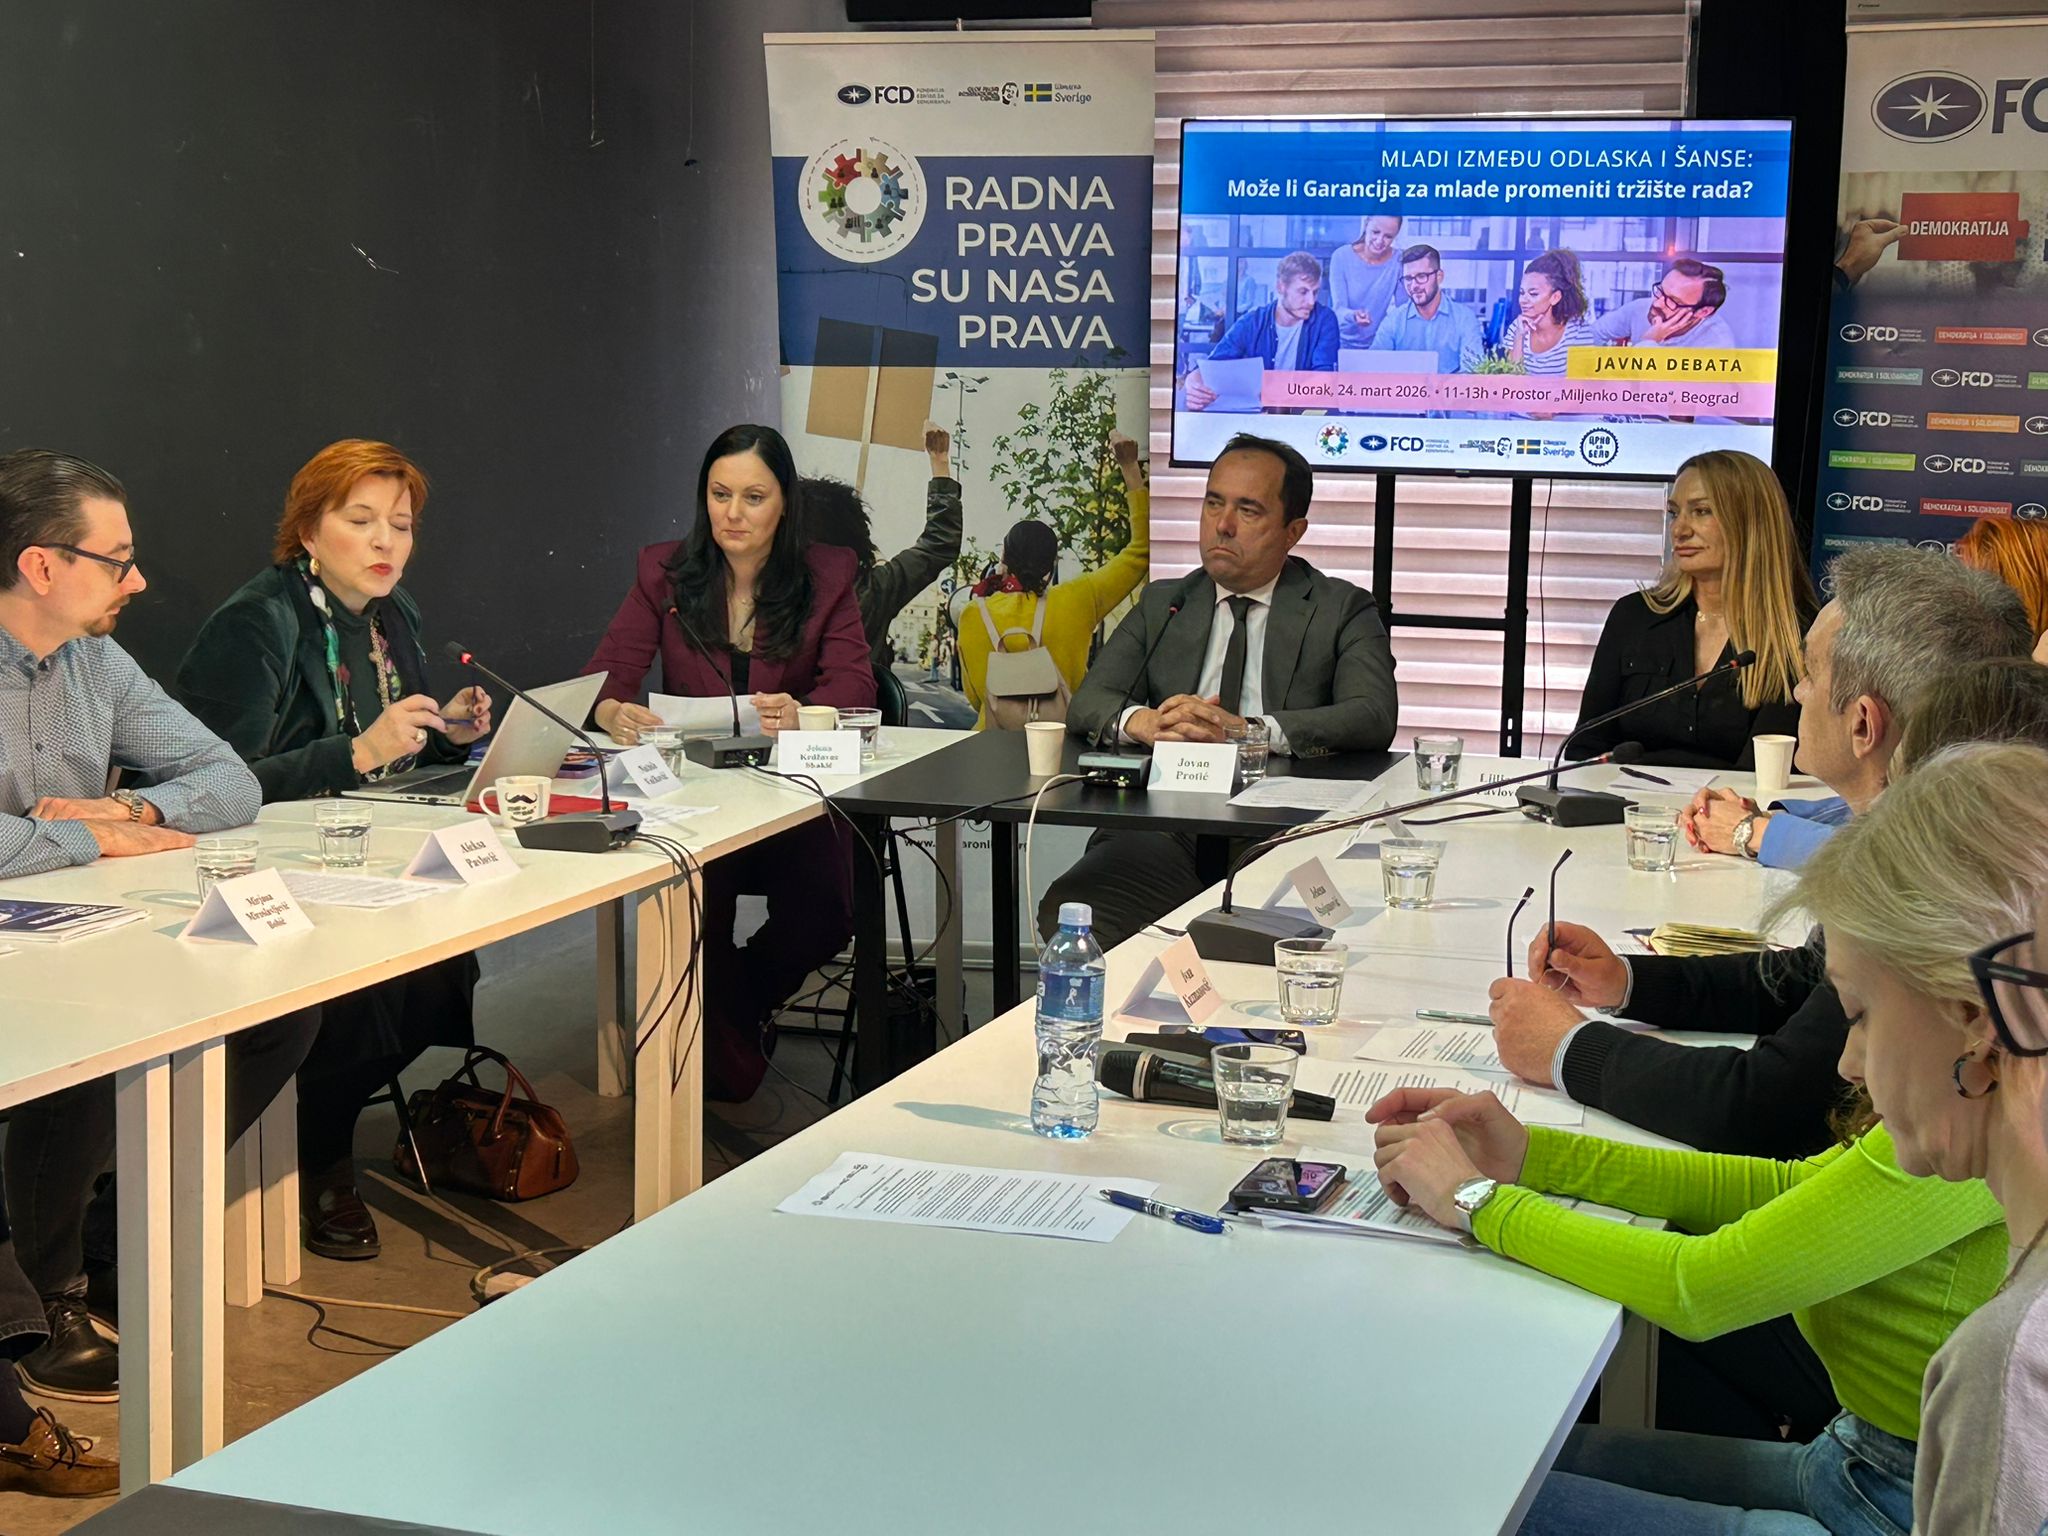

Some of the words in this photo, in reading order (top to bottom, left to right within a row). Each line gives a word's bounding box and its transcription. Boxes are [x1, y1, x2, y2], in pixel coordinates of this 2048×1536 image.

[874, 86, 915, 104] FCD
[1381, 149, 1448, 168] MLADI
[1457, 149, 1542, 168] IZMEĐU
[1550, 149, 1653, 168] ODLASKA
[1661, 149, 1666, 167] I
[1674, 144, 1753, 168] ŠANSE:
[945, 176, 1115, 211] RADNA
[1227, 178, 1281, 197] Može
[1286, 178, 1298, 197] li
[1303, 179, 1400, 203] Garancija
[1405, 183, 1428, 198] za
[1434, 179, 1499, 198] mlade
[1505, 180, 1611, 203] promeniti
[1617, 180, 1686, 199] tržište
[1692, 180, 1753, 199] rada?
[1909, 221, 2009, 236] DEMOKRATIJA
[957, 222, 1115, 257] PRAVA
[911, 268, 970, 303] SU
[987, 260, 1115, 303] NAŠA
[958, 315, 1115, 349] PRAVA
[1866, 326, 1899, 342] FCD
[1595, 356, 1657, 373] JAVNA
[1667, 358, 1742, 372] DEBATA
[1961, 371, 1994, 387] FCD
[1287, 383, 1334, 398] Utorak,
[1337, 384, 1358, 397] 24.
[1360, 385, 1392, 397] mart
[1395, 385, 1431, 398] 2026.
[1444, 386, 1489, 400] 11-13h
[1502, 387, 1551, 400] Prostor
[1681, 391, 1740, 407] Beograd
[1859, 411, 1891, 427] FCD
[1390, 436, 1424, 452] FCD
[1953, 457, 1986, 473] FCD
[1851, 495, 1884, 511] FCD
[1177, 757, 1210, 768] Jovan
[1175, 770, 1209, 781] Protić
[460, 840, 487, 853] Aleksa
